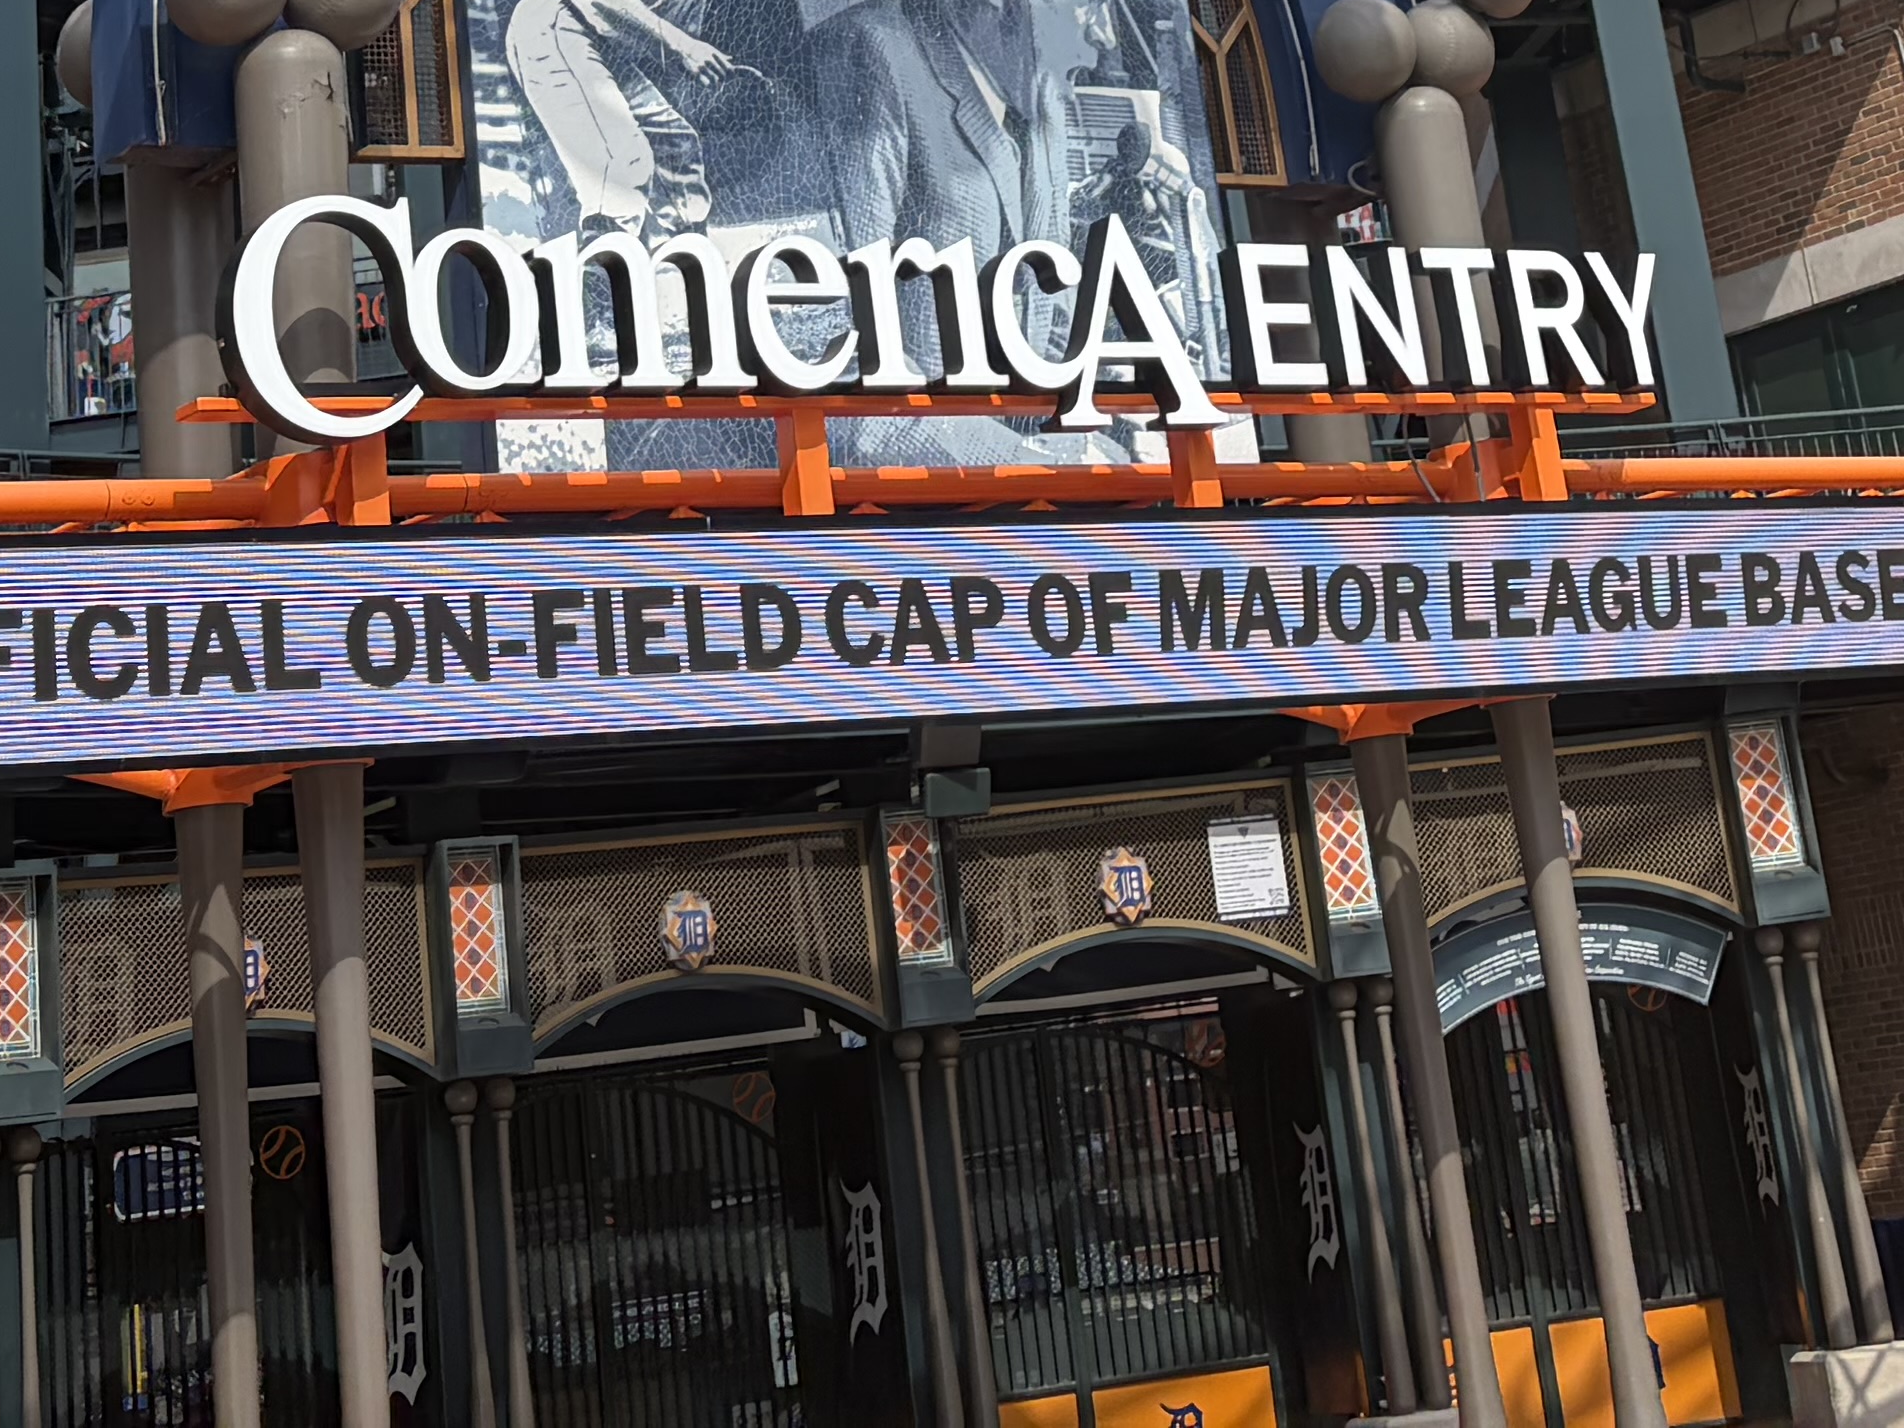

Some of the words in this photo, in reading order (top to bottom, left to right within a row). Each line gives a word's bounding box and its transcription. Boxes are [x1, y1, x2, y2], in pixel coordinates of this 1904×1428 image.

[1237, 245, 1656, 390] ENTRY
[344, 581, 802, 689] ON-FIELD
[824, 573, 1003, 668] CAP
[1027, 567, 1133, 658] OF
[1157, 559, 1429, 653] MAJOR
[1446, 549, 1727, 641] LEAGUE
